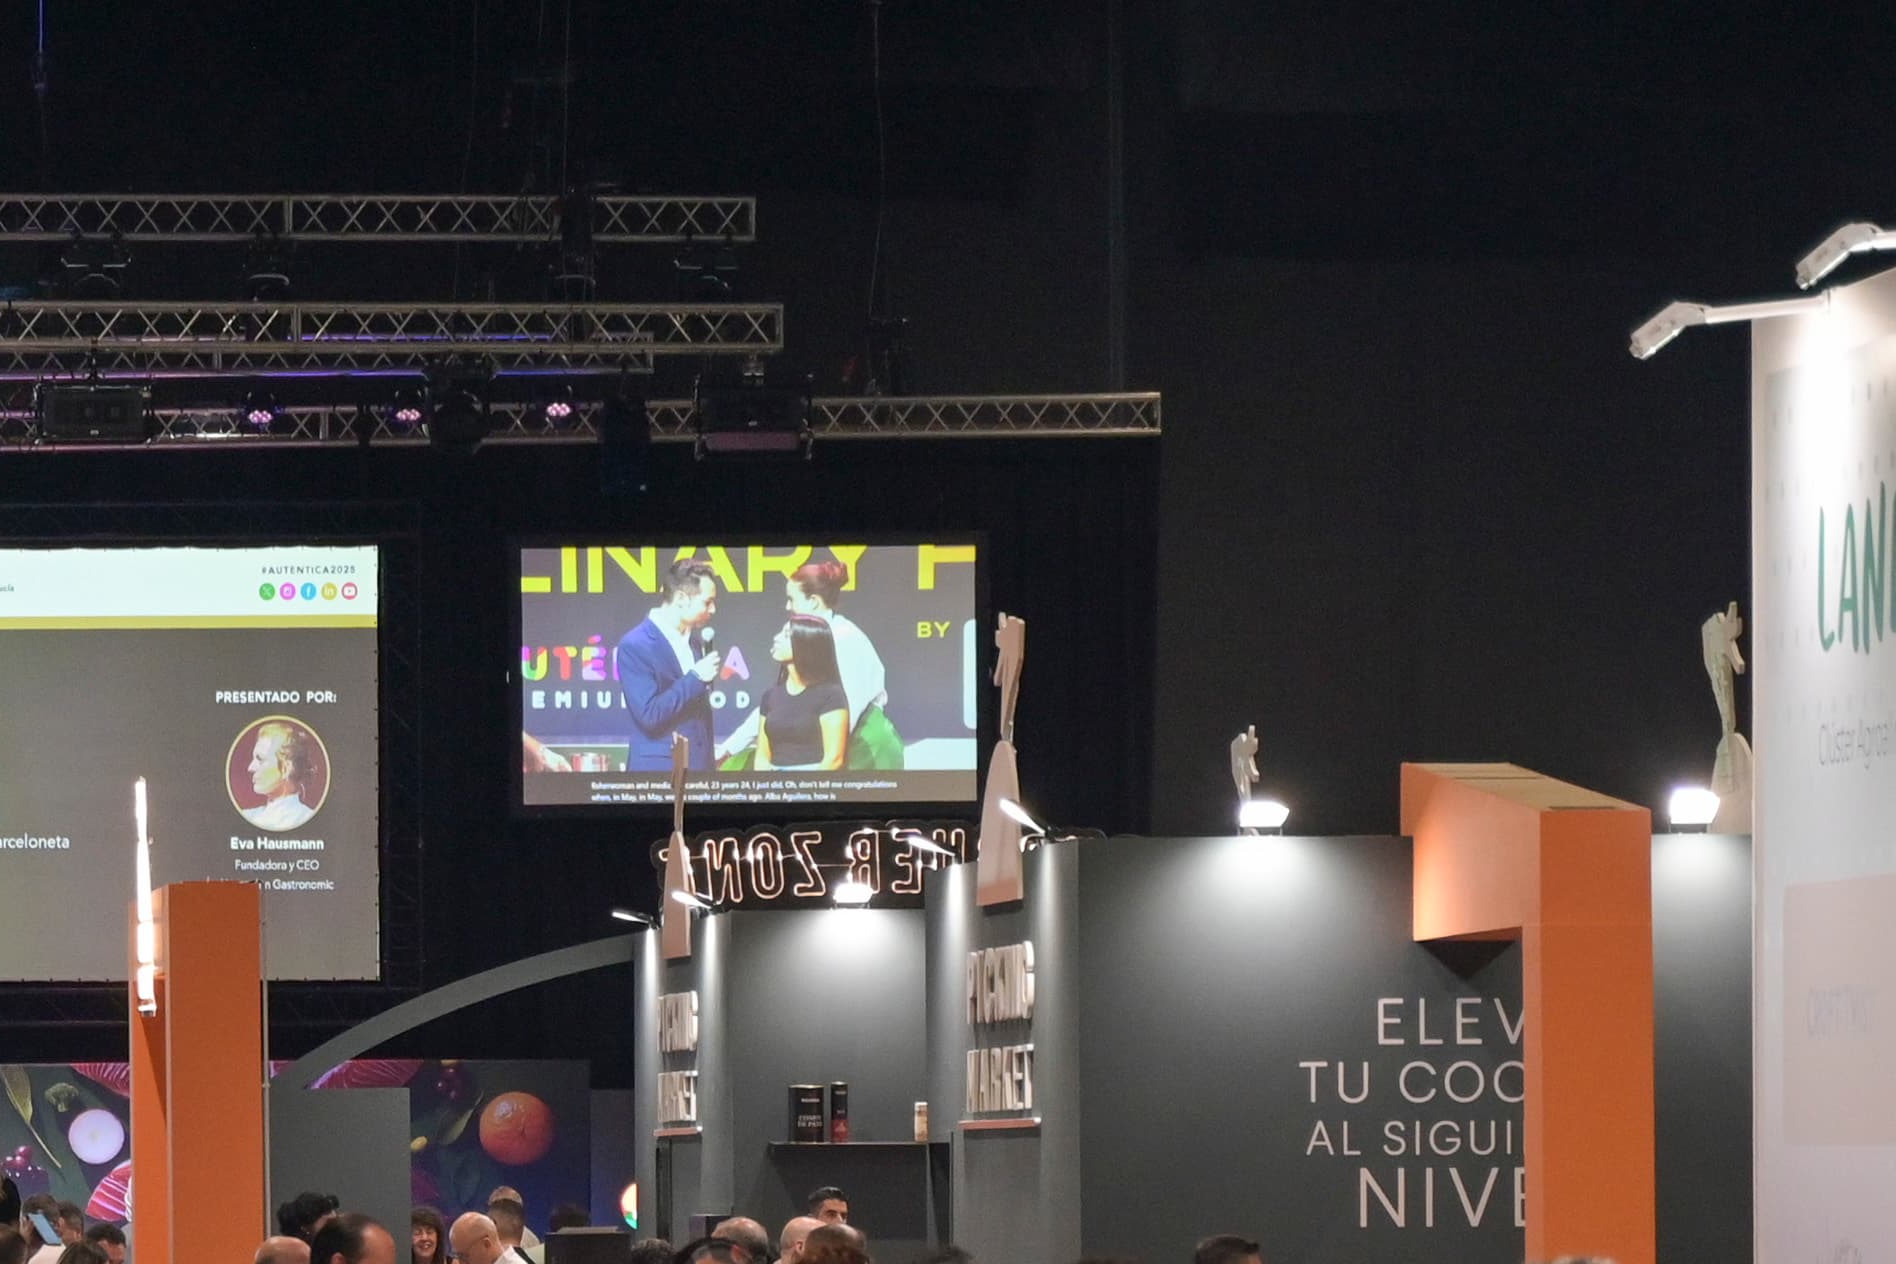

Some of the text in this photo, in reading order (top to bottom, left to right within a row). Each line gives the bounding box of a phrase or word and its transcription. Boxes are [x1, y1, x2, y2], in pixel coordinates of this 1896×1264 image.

[262, 566, 356, 575] #AUTENTICA2025
[521, 545, 868, 593] INARY
[917, 622, 951, 638] BY
[216, 690, 337, 704] PRESENTADO POR:
[230, 837, 325, 850] Eva Hausmann
[235, 859, 320, 873] Fundadora y CEO
[272, 879, 335, 891] Gastronomic
[1378, 998, 1524, 1045] ELEV
[1299, 1061, 1371, 1103] TU
[1306, 1120, 1525, 1156] AL SIGUI
